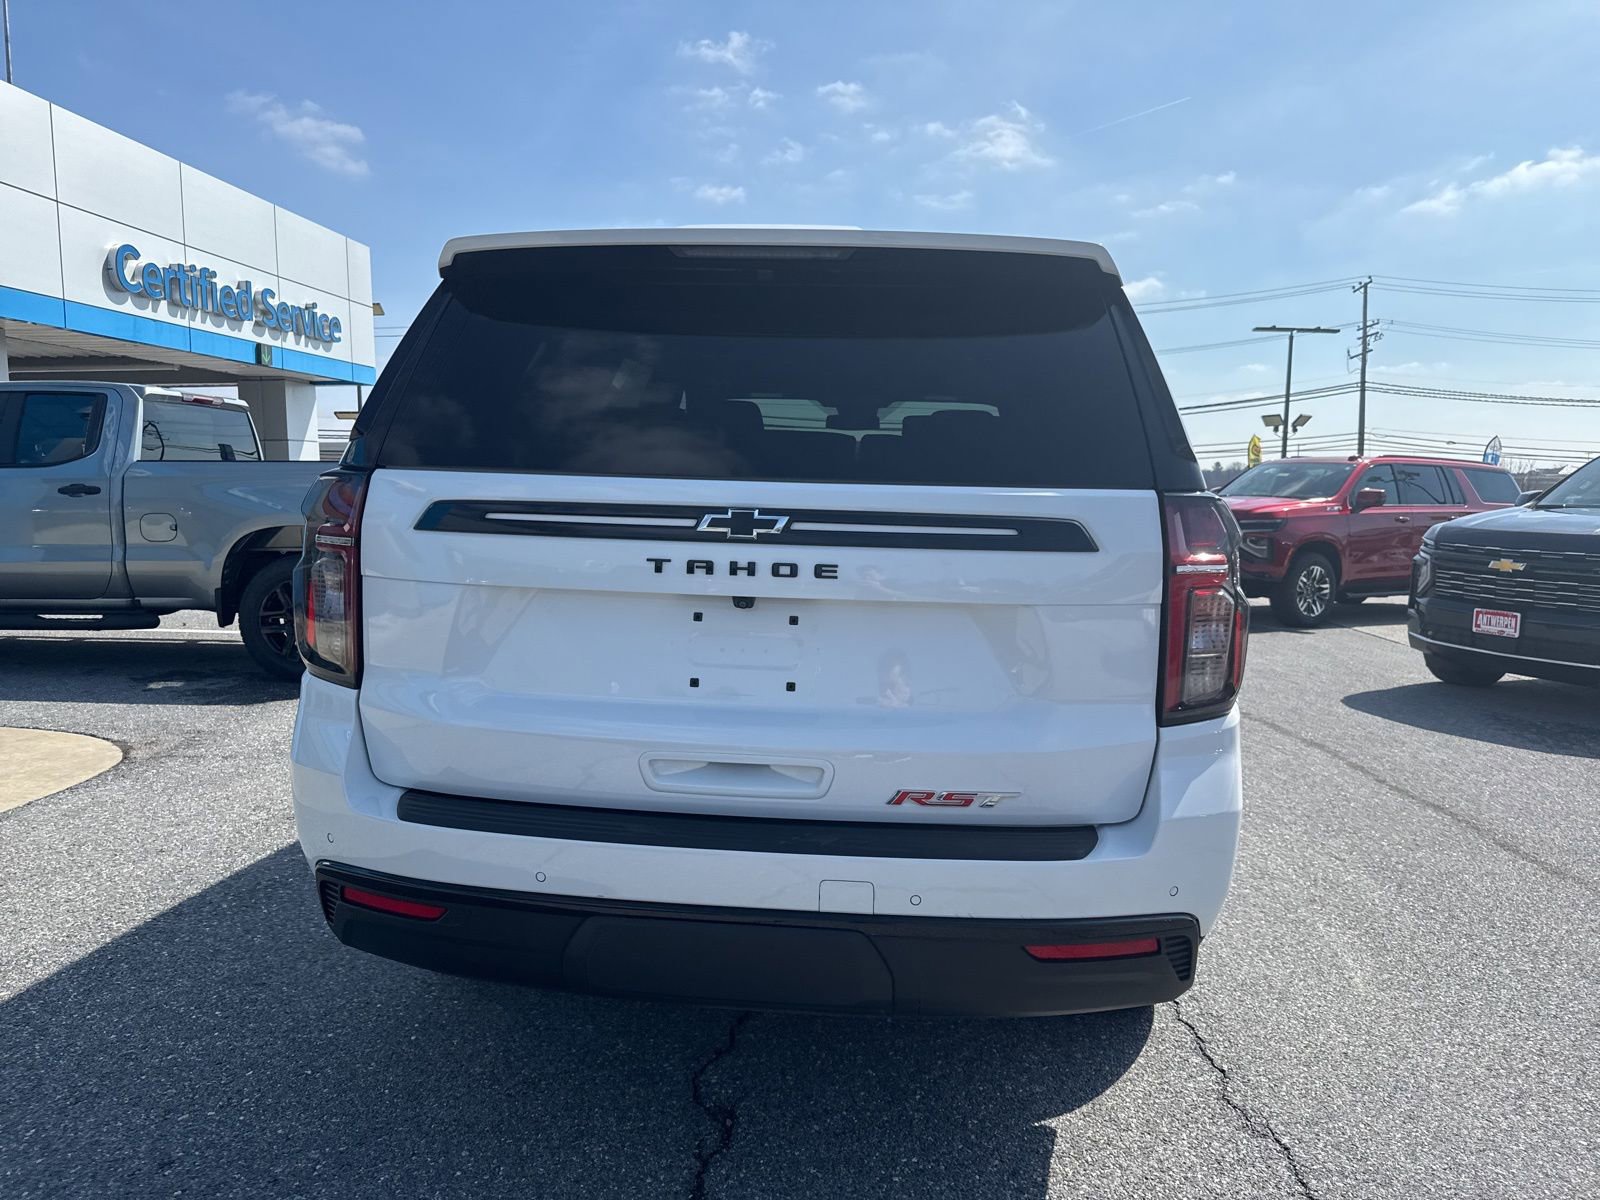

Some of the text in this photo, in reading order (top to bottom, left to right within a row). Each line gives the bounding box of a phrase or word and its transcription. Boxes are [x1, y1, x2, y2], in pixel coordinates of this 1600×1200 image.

[110, 243, 342, 343] Certified Service
[646, 557, 839, 580] TAHOE
[1476, 613, 1516, 630] ANTWERPEN
[886, 789, 1021, 808] RST
